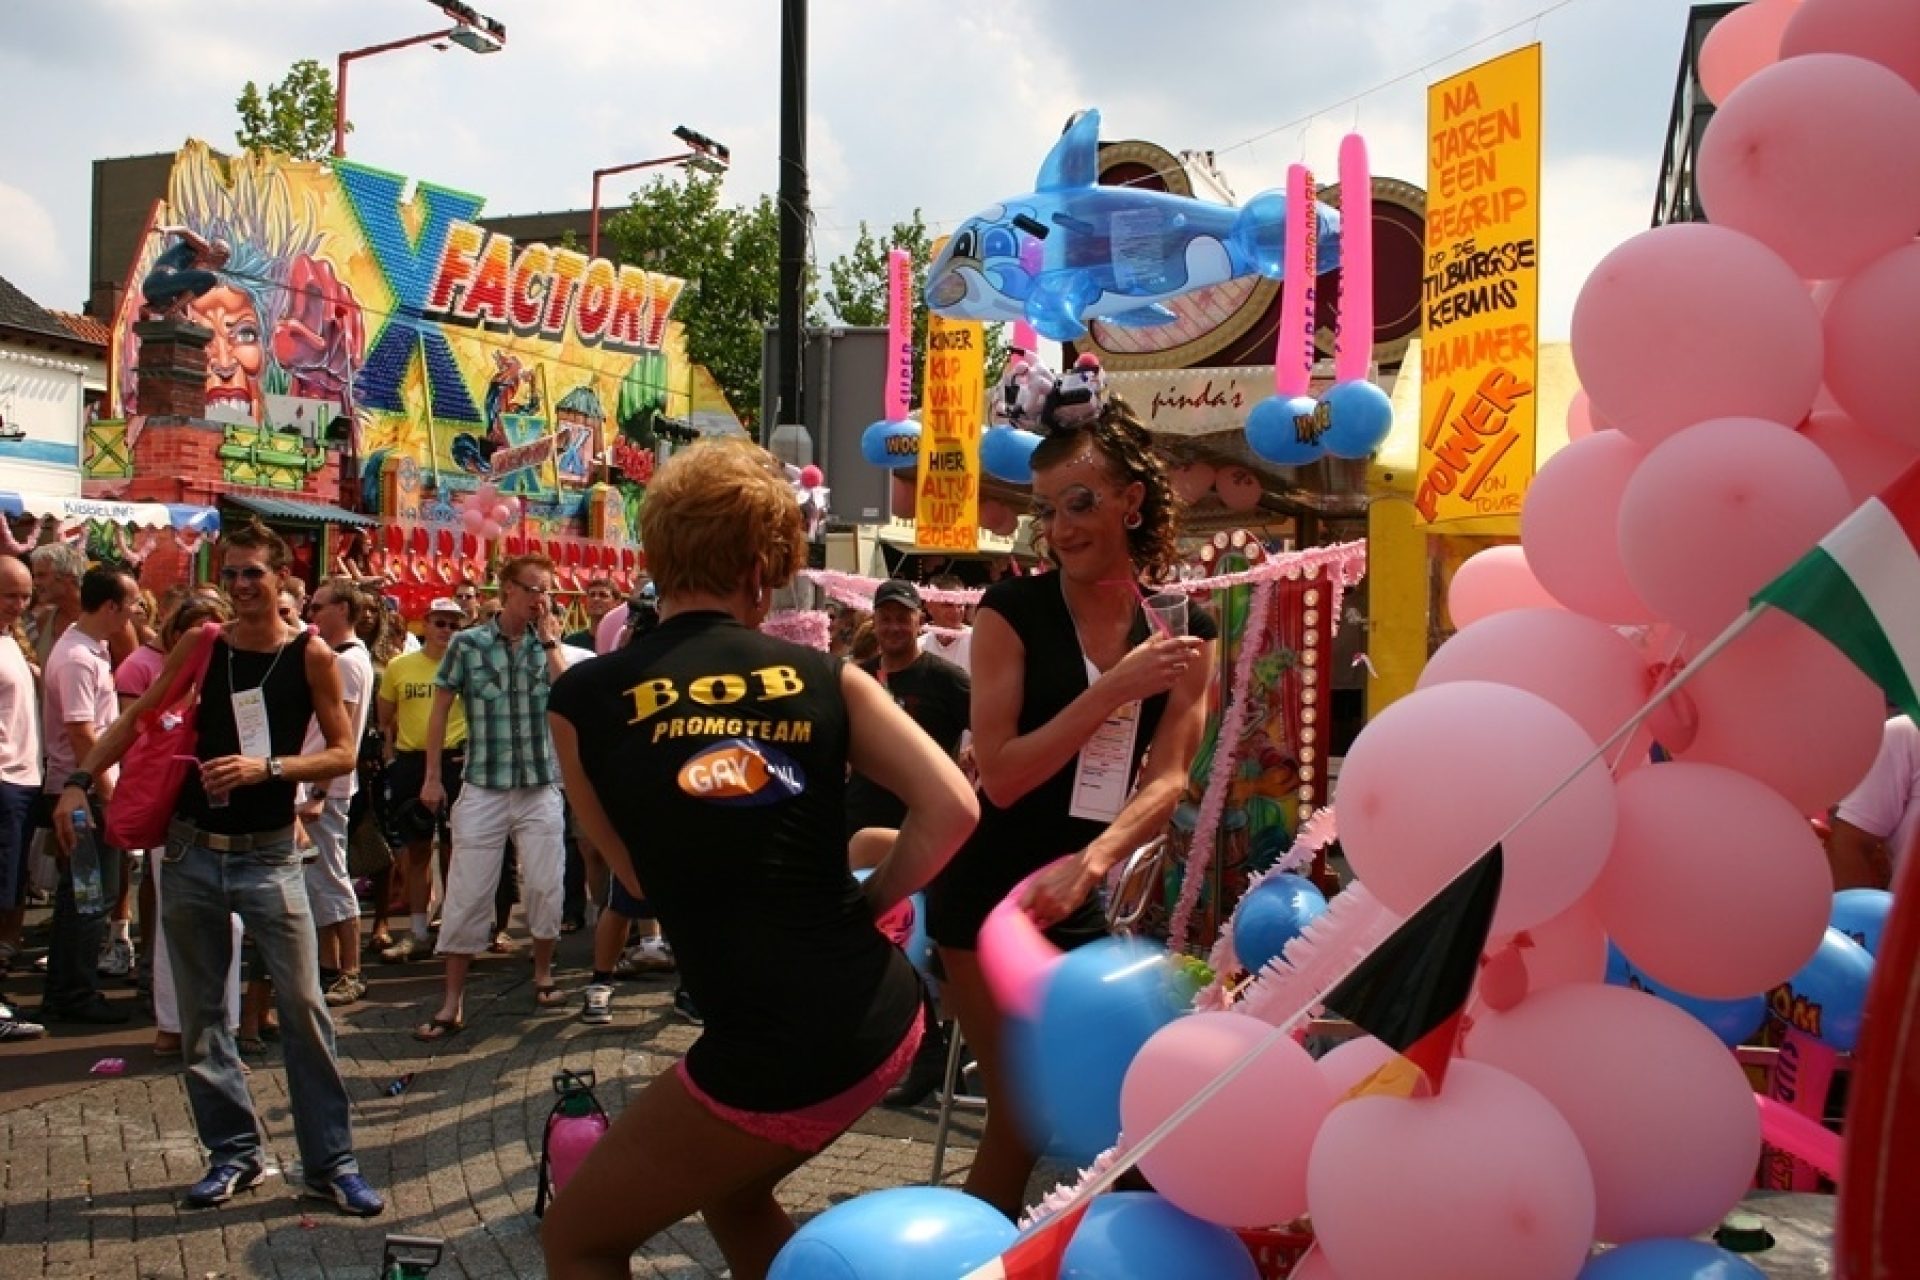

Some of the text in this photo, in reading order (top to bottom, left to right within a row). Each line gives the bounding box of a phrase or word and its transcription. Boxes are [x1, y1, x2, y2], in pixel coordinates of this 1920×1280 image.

[1443, 80, 1481, 122] NA
[1432, 102, 1522, 169] JAREN
[1440, 150, 1497, 199] EEN
[1427, 186, 1528, 248] BEGRIP
[1422, 238, 1535, 302] TILBURGSE
[1429, 238, 1476, 272] OP DE
[332, 157, 686, 428] X FACTORY
[1428, 279, 1518, 332] KERMIS
[929, 329, 974, 351] KINDER
[1422, 323, 1532, 384] HAMMER
[930, 356, 961, 379] KOP
[928, 384, 962, 407] VAN
[1151, 379, 1244, 420] pinda's
[929, 451, 965, 472] HIER
[1414, 366, 1533, 524] POWER
[1473, 493, 1521, 513] TOUR
[1482, 474, 1507, 493] ON
[622, 664, 805, 726] BOB
[651, 715, 812, 744] PROMOTEAM
[687, 755, 755, 794] GAY
